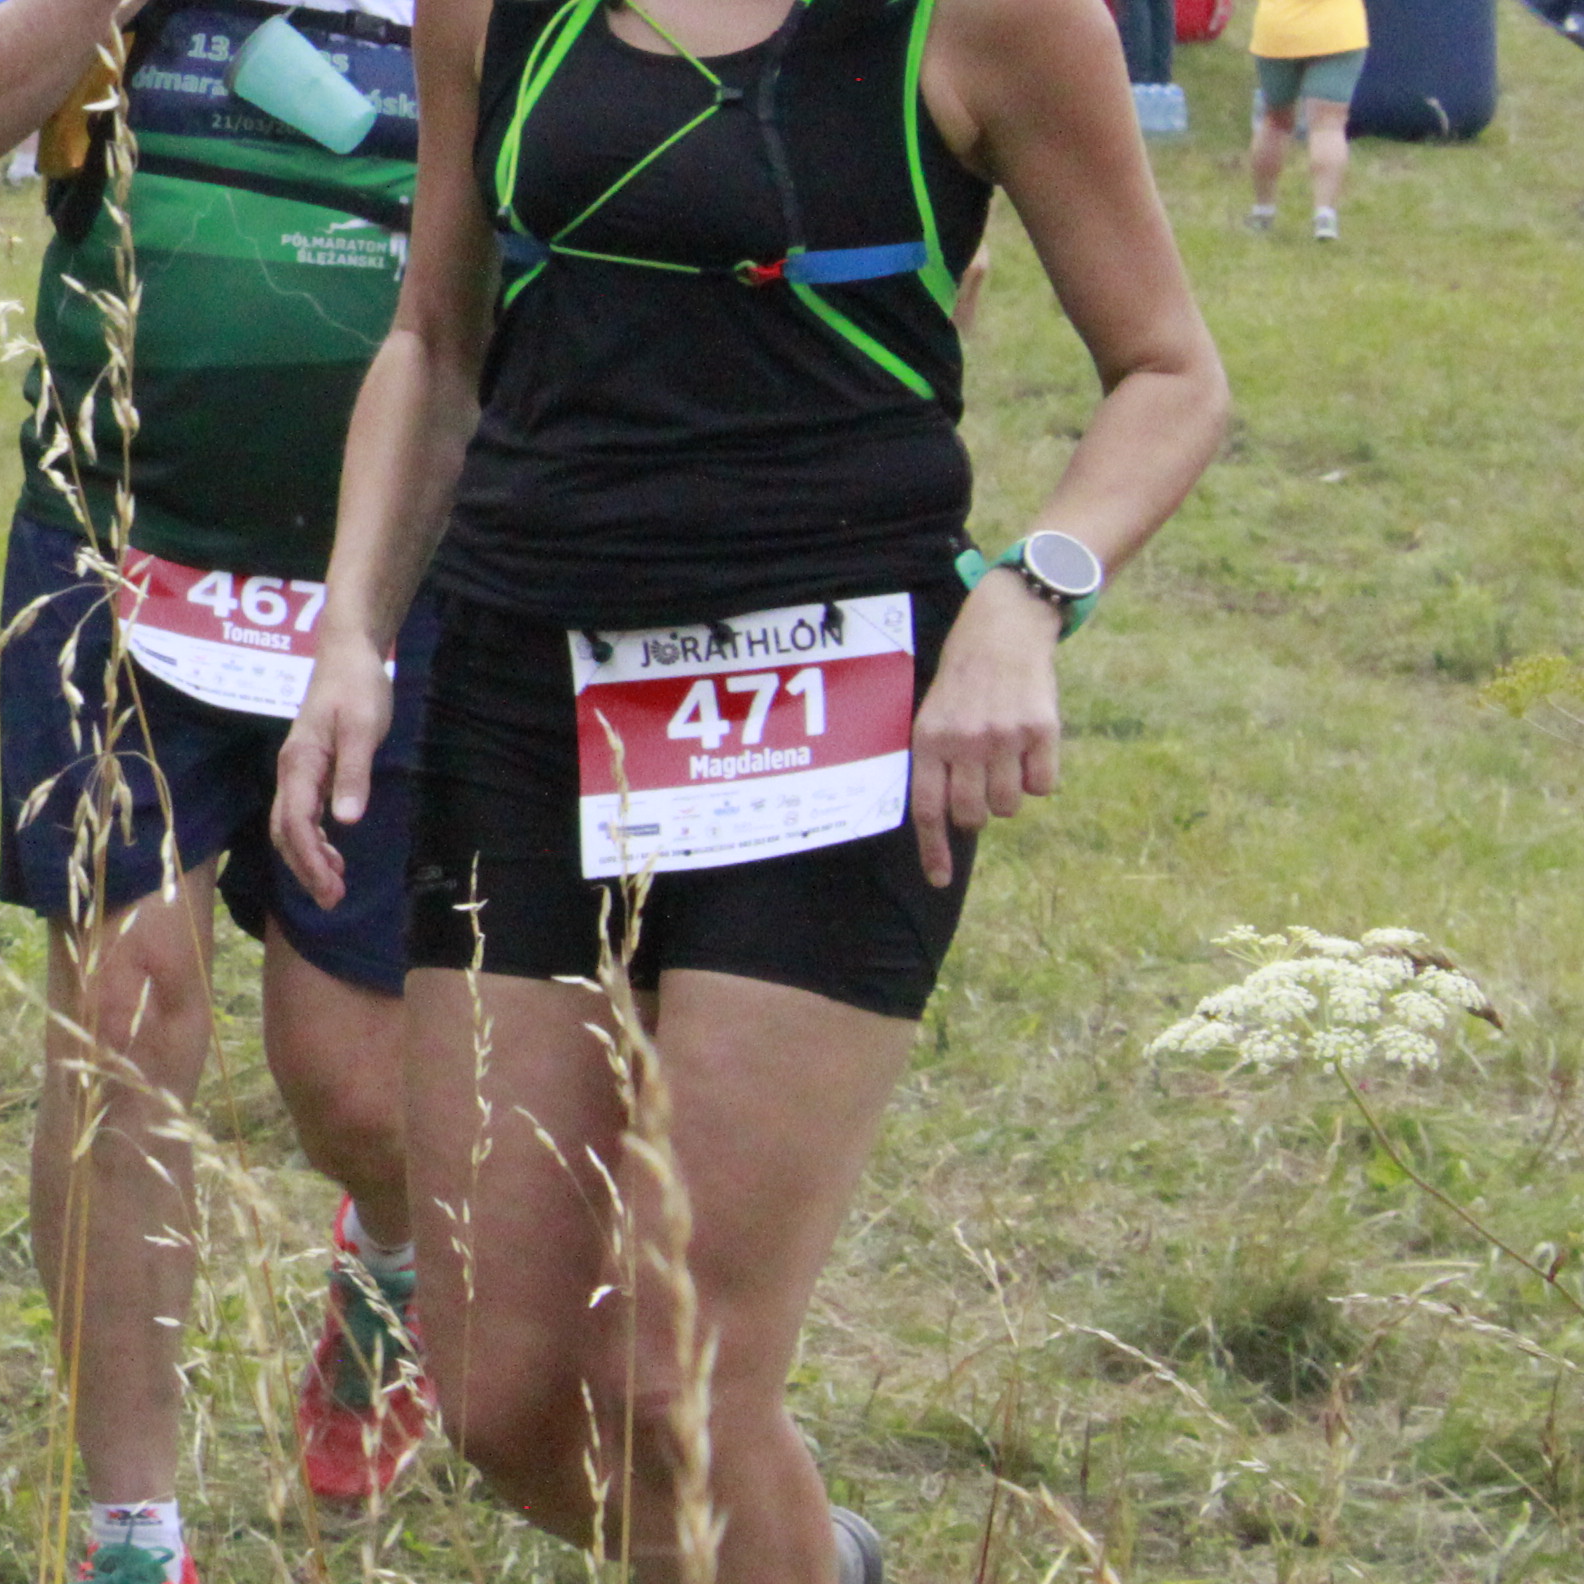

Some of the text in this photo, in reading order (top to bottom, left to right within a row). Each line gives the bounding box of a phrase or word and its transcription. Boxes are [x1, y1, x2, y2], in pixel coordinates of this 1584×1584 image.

[187, 570, 328, 633] 467
[222, 620, 292, 651] Tomasz
[666, 667, 829, 750] 471
[689, 746, 811, 780] Magdalena
